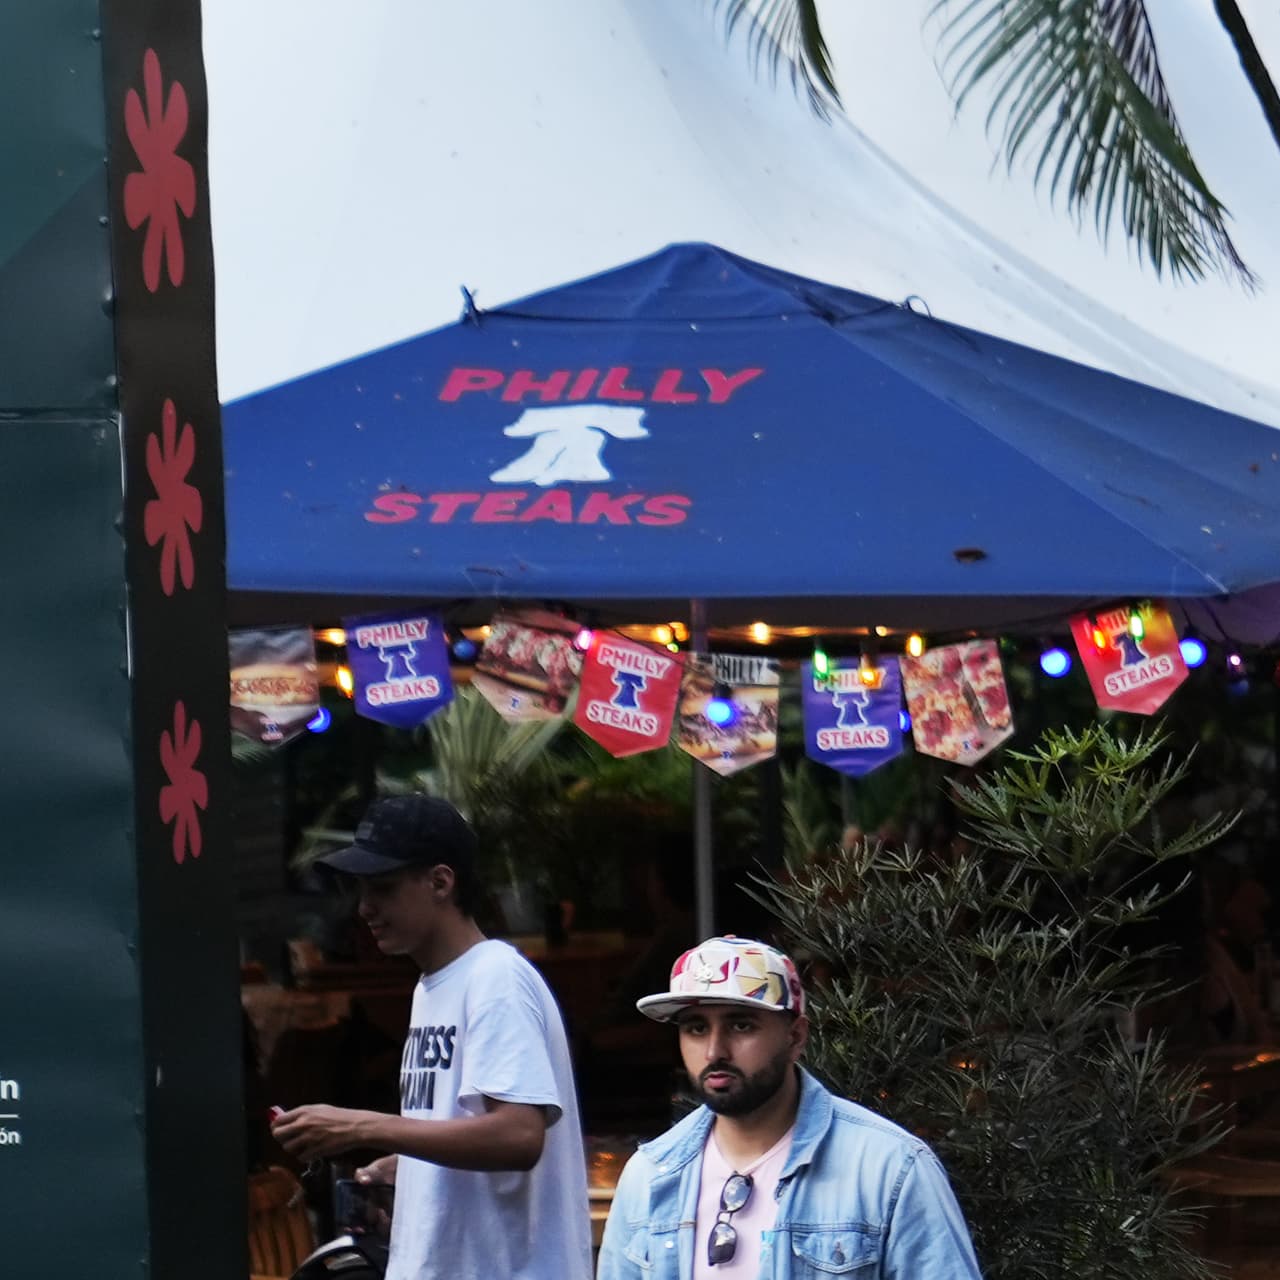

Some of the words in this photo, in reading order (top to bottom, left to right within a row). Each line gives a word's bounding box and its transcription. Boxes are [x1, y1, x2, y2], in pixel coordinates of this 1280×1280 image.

[438, 367, 766, 404] PHILLY
[364, 490, 692, 526] STEAKS
[357, 620, 428, 647] PHILLY
[600, 645, 668, 677] PHILLY
[1106, 657, 1172, 693] STEAKS
[368, 679, 438, 703] STEAKS
[589, 702, 655, 733] STEAKS
[819, 729, 887, 748] STEAKS
